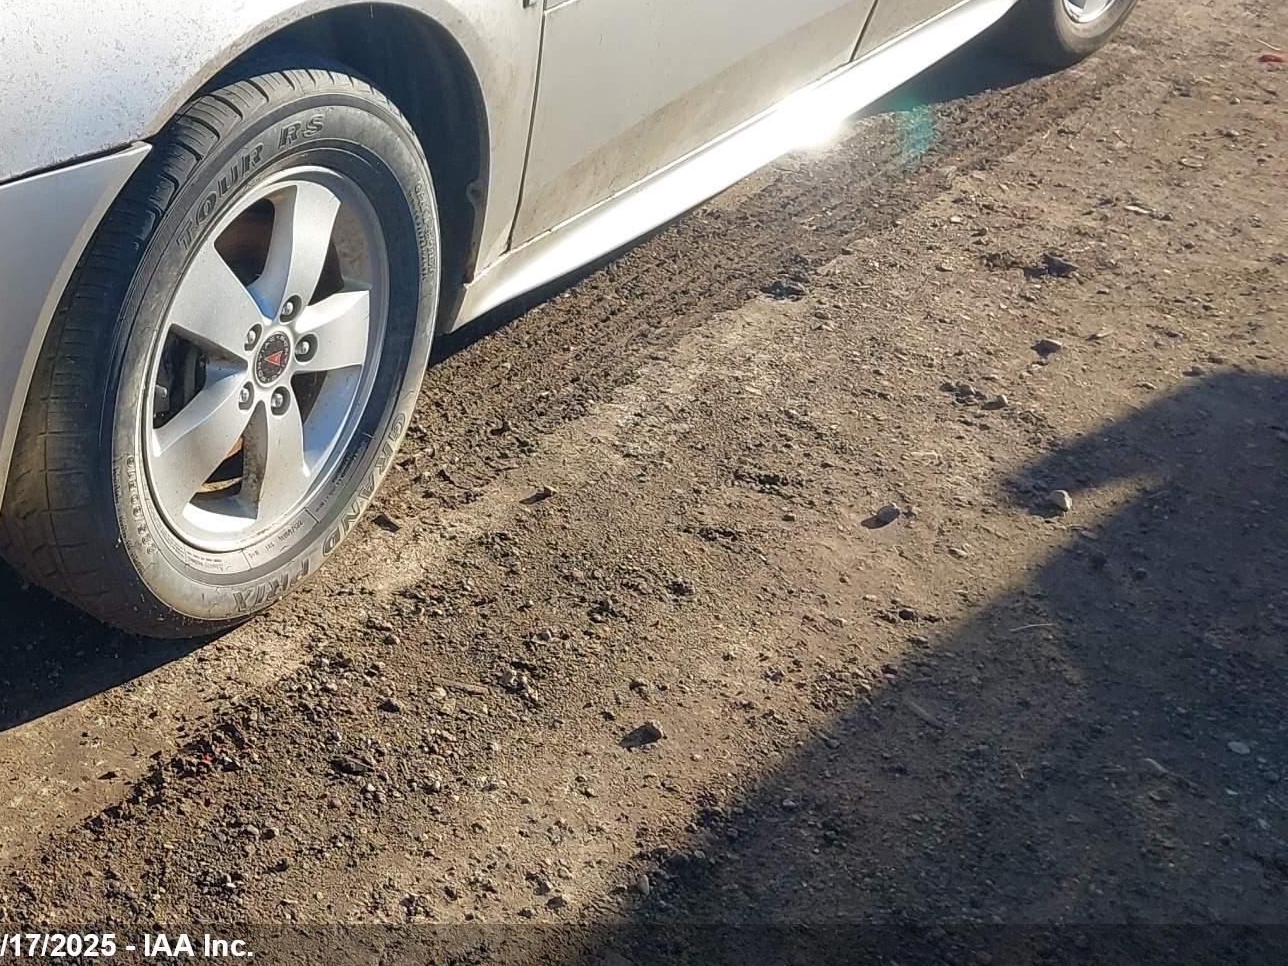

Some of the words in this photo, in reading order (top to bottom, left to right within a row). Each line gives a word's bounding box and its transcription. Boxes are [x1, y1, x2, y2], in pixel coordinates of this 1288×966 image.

[176, 142, 265, 251] TOUR
[278, 113, 326, 150] RS
[322, 411, 409, 557] GRAND
[232, 555, 311, 613] PRIX
